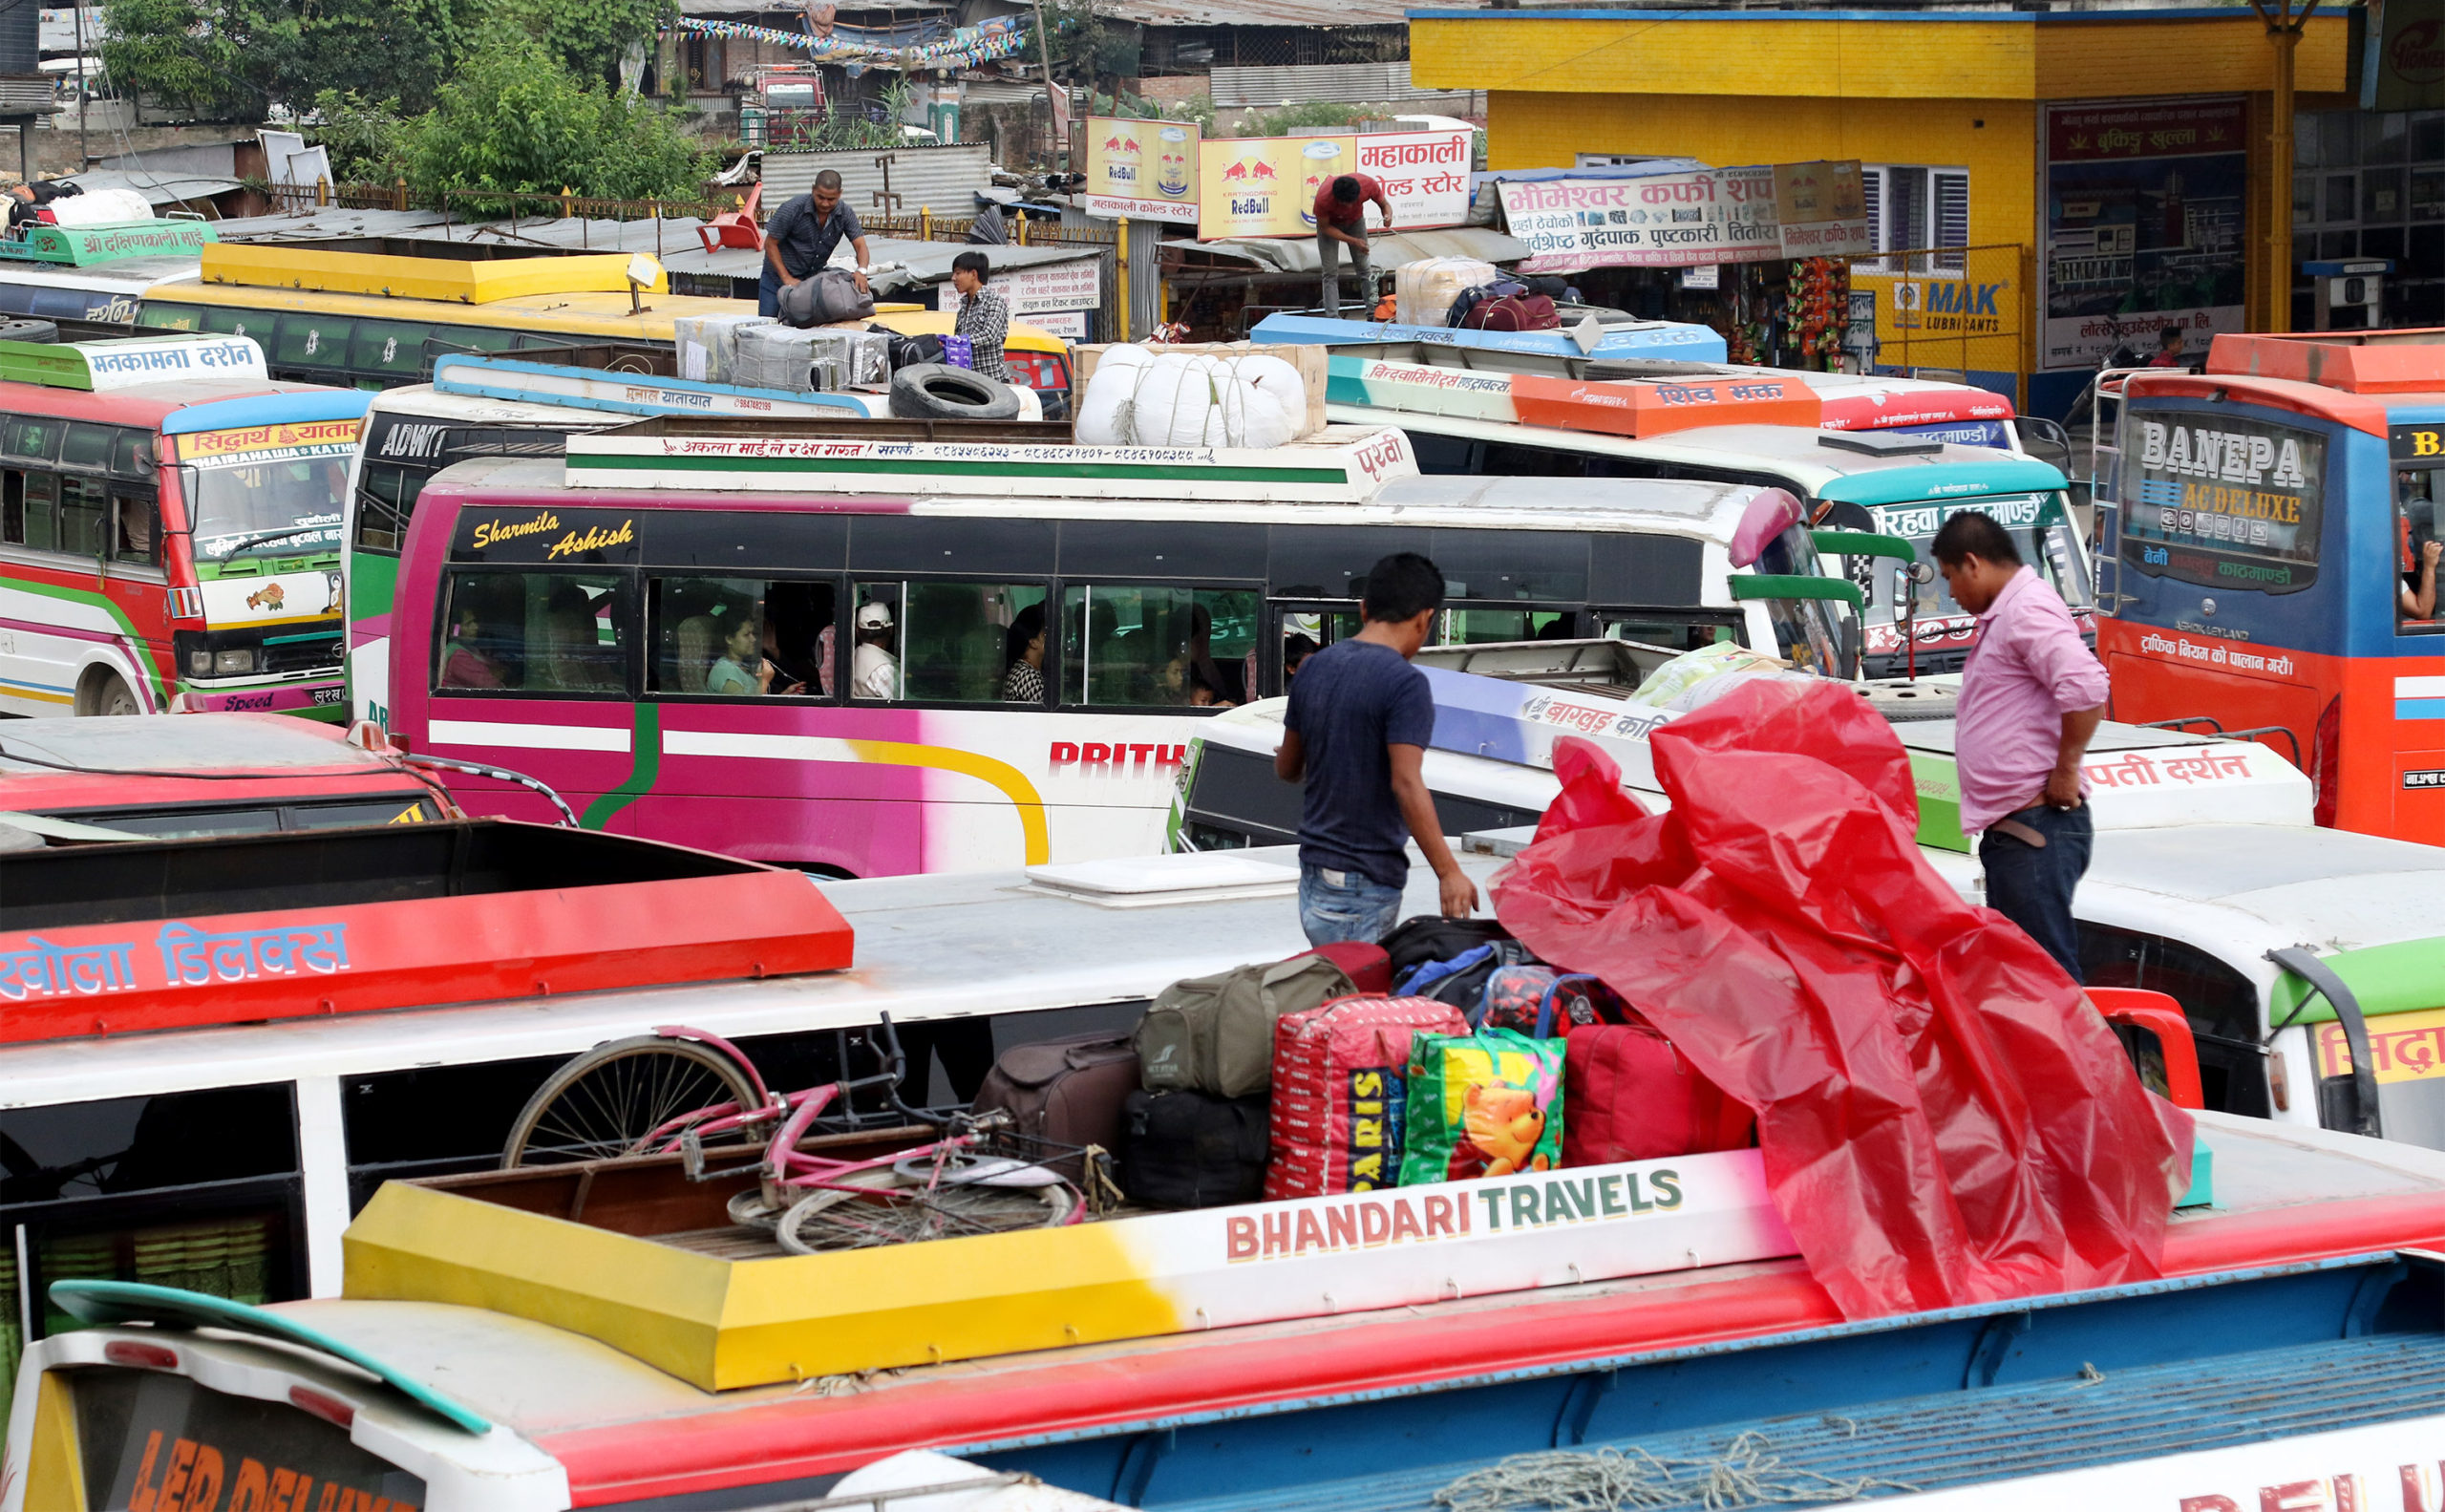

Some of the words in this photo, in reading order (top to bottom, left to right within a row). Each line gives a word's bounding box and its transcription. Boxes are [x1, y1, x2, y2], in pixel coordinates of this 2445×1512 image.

[1360, 135, 1467, 168] महाकाली
[1109, 165, 1137, 181] RedBull
[1376, 175, 1414, 197] ोल्ड
[1421, 172, 1466, 195] स्टोर
[1092, 199, 1137, 213] महाकाली
[1139, 202, 1166, 215] कोल्ड
[1170, 203, 1194, 217] स्टोर
[1231, 197, 1269, 215] RedBull
[1508, 181, 1629, 211] भीमेश्वर
[1640, 174, 1716, 204] कफी
[1727, 178, 1774, 202] शप
[1926, 283, 2000, 315] MAK
[91, 349, 191, 375] मनकामना
[197, 341, 254, 368] दर्शन
[626, 387, 660, 403] मुनाल
[662, 392, 713, 409] यातायात
[1655, 385, 1718, 406] शिव
[1729, 384, 1784, 401] भक्त
[194, 426, 272, 453] सिद्धार्थ
[1918, 424, 1988, 443] ठमाण्डौ
[2412, 431, 2445, 457] B
[1353, 433, 1405, 482] पृथ्वी
[2140, 421, 2306, 488] BANEPA
[2182, 482, 2210, 511] AC
[2213, 486, 2302, 523] DELUXE
[473, 510, 560, 548] Sharmila
[547, 519, 634, 561] Ashish
[2143, 545, 2169, 566] बेनी
[2218, 561, 2292, 586] काठमाण्डौ
[2175, 620, 2205, 635] ASHOK
[2206, 625, 2250, 641] LEYLAND
[2140, 633, 2178, 655] ट्राफिक
[2179, 638, 2209, 661] नियम
[2211, 645, 2227, 665] को
[224, 692, 275, 713] Speed
[1048, 740, 1186, 781] PRITH
[2160, 749, 2252, 786] दर्शन
[155, 921, 351, 986] डिलक्स
[1225, 1190, 1472, 1263] BHANDARI
[1477, 1167, 1685, 1234] TRAVELS
